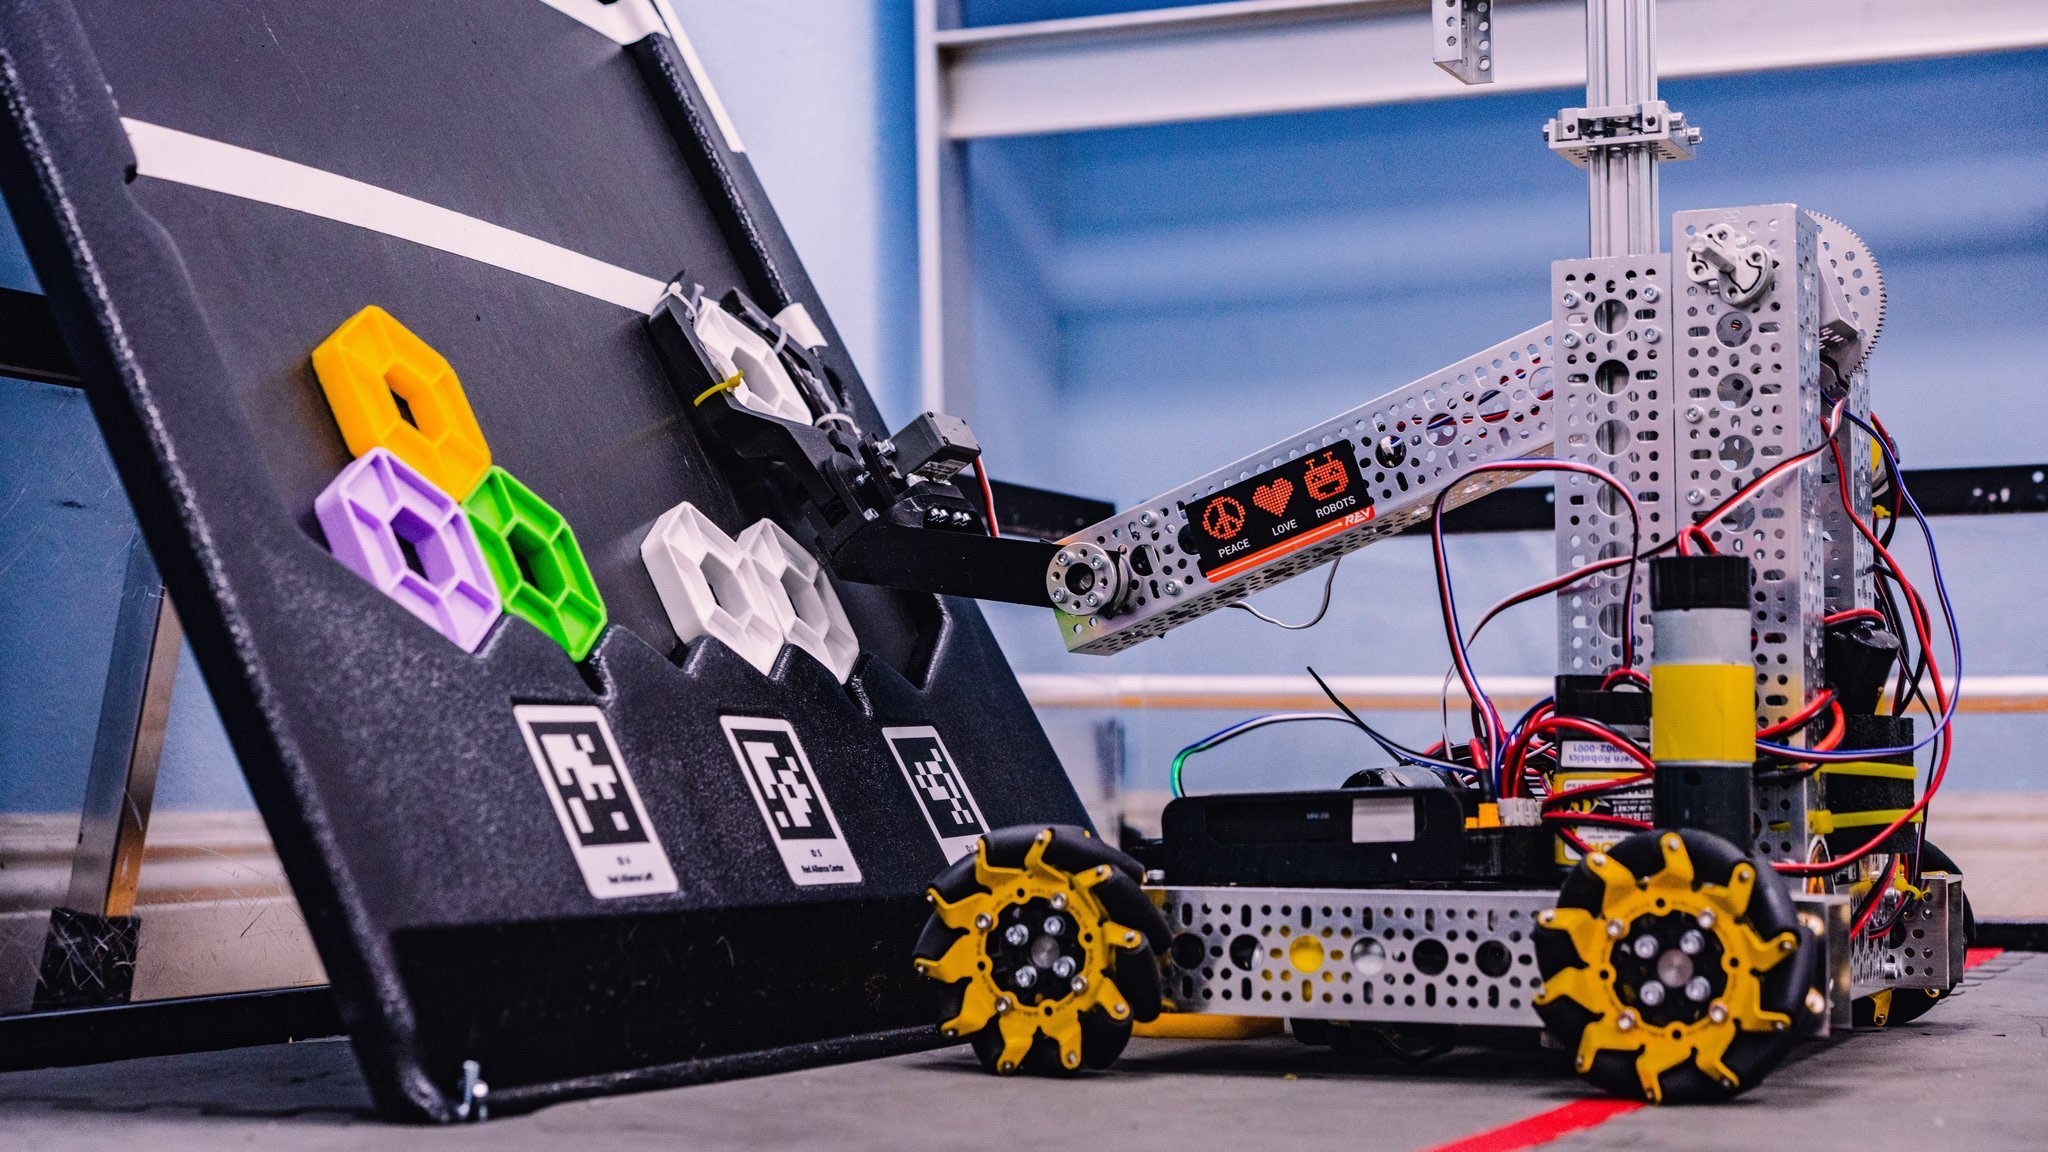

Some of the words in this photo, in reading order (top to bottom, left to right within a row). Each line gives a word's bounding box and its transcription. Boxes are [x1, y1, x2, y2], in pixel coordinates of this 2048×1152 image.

[1218, 538, 1250, 558] PEACE
[1271, 518, 1298, 537] LOVE
[1315, 495, 1356, 518] ROBOTS
[1345, 506, 1371, 527] REV
[1569, 754, 1611, 764] Robotics
